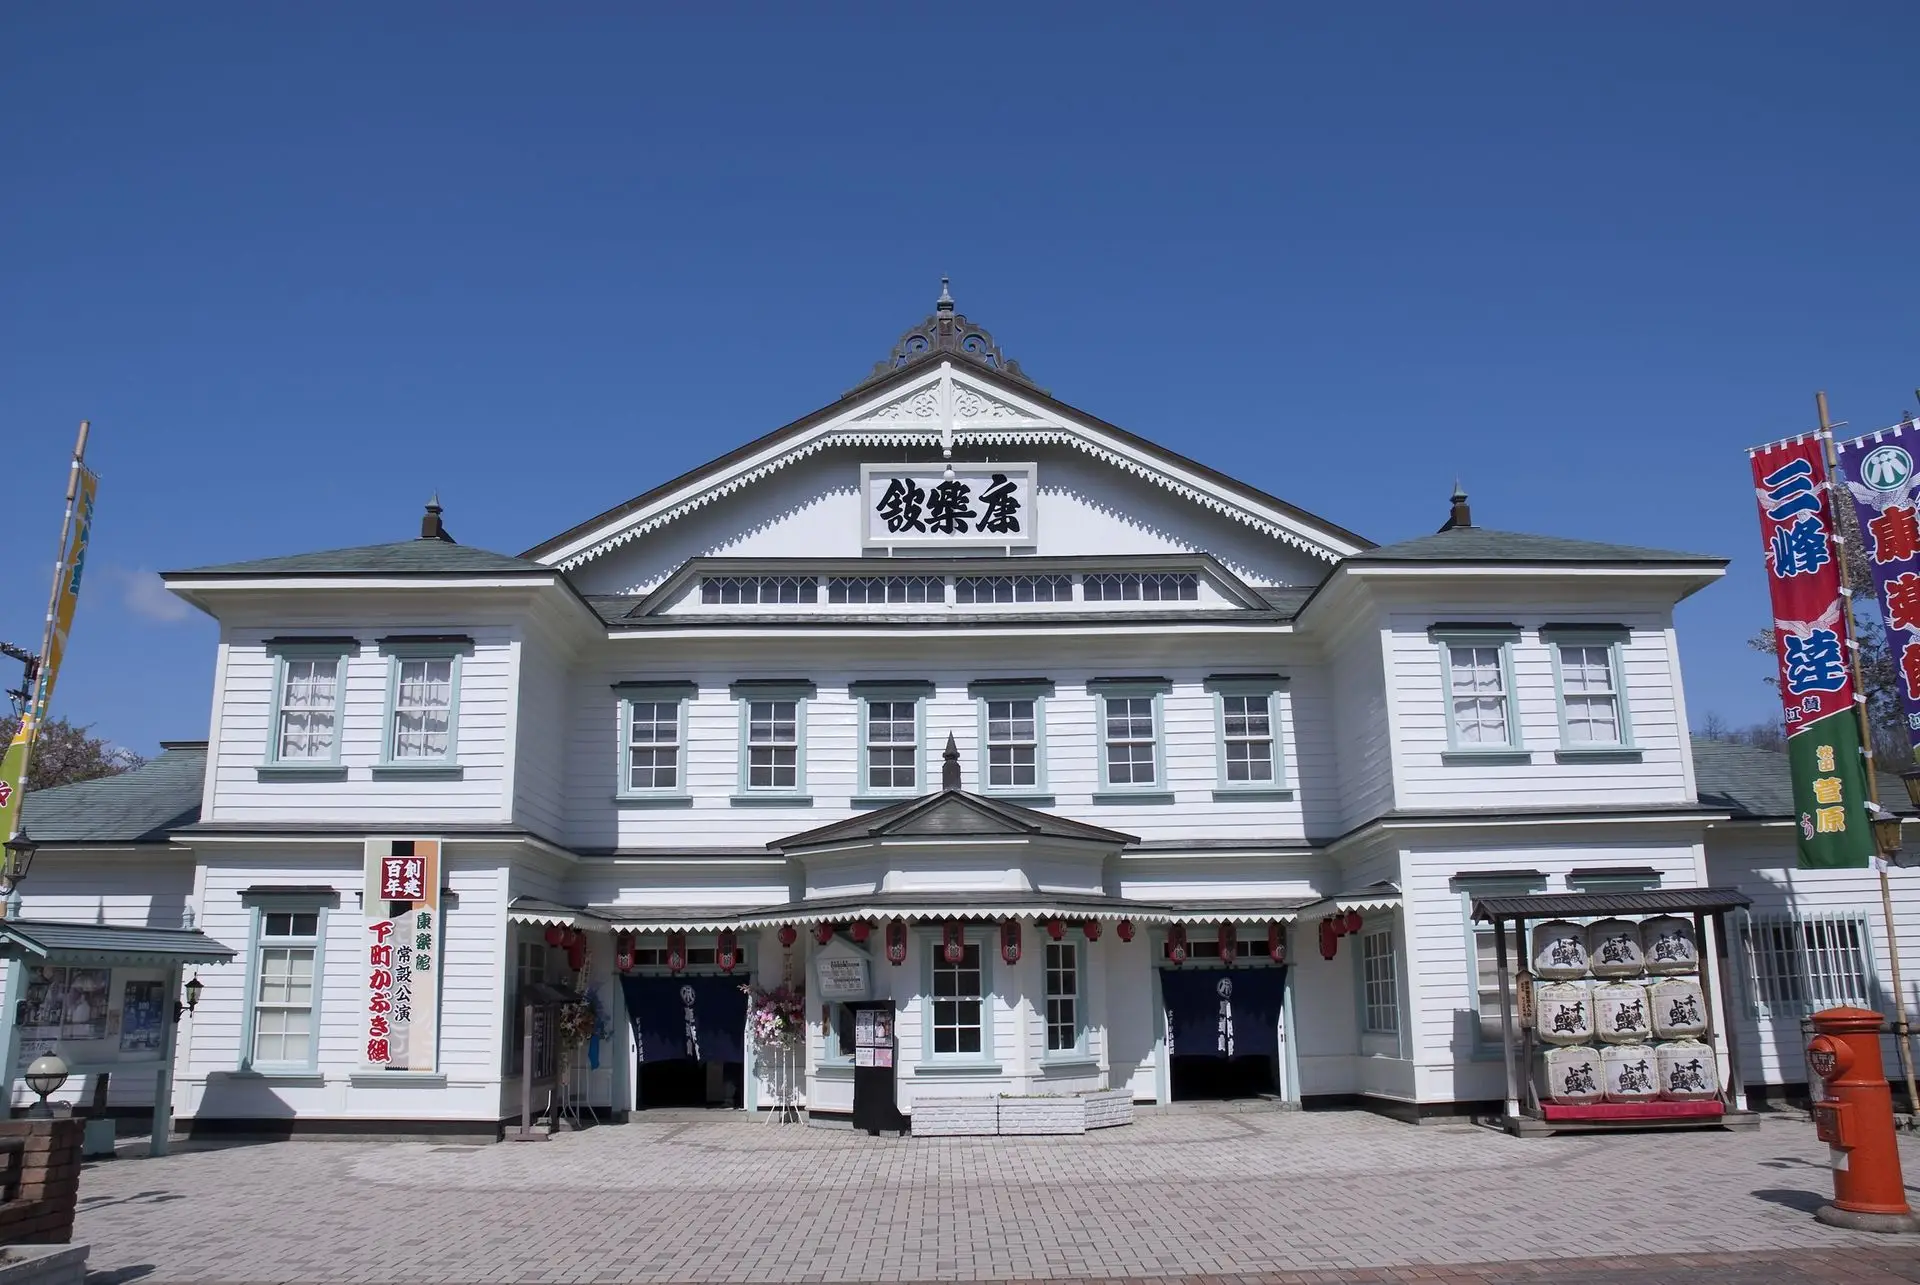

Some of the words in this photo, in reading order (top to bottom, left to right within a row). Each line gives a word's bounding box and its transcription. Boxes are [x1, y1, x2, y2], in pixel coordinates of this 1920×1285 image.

[1800, 811, 1815, 841] より
[1813, 776, 1846, 833] 菅原
[384, 859, 403, 898] 百年
[404, 859, 422, 898] 創建
[366, 920, 395, 1064] 下町かぶき組
[394, 944, 414, 1023] 常設公演
